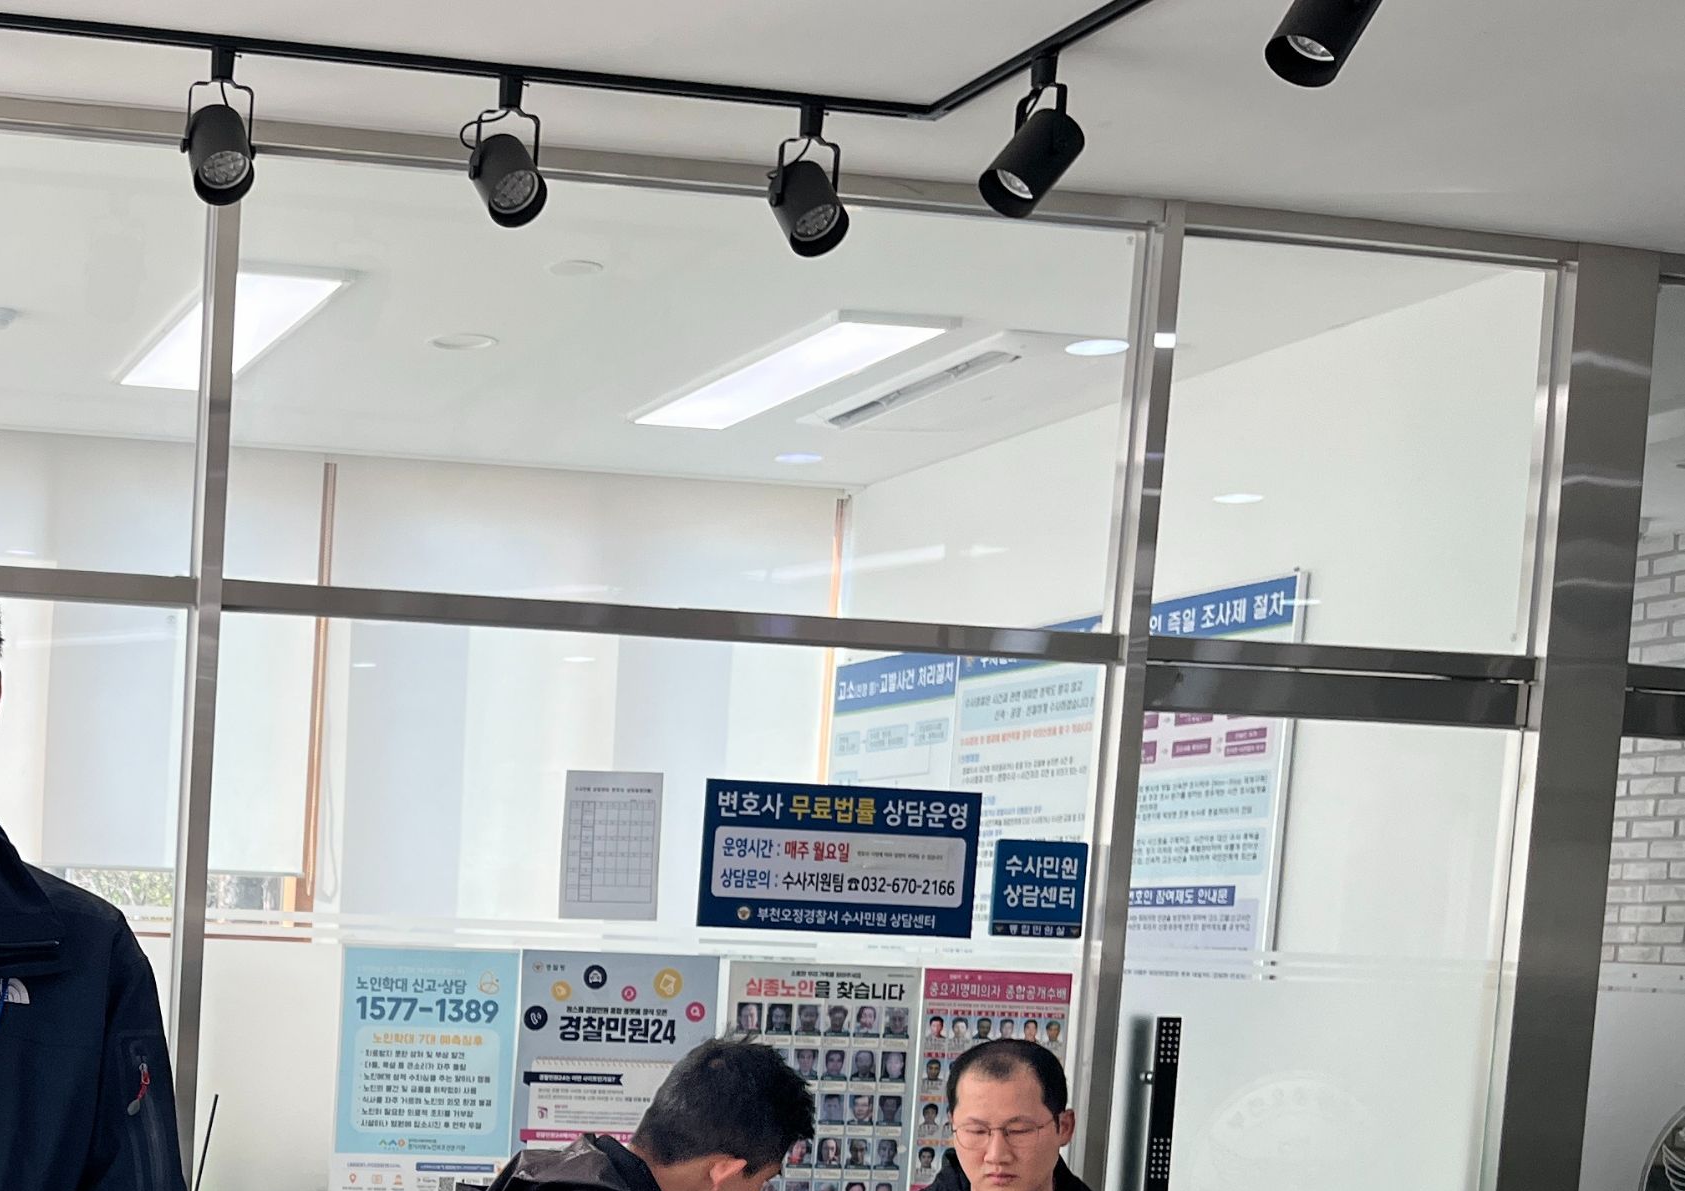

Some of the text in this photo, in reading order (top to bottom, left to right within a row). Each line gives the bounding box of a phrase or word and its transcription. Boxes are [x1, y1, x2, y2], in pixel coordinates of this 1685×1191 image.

[1200, 597, 1247, 629] 조사제
[1253, 590, 1285, 621] 절차
[717, 790, 784, 820] 변호사
[789, 795, 876, 826] 무료법률
[882, 799, 970, 830] 상담운영
[722, 837, 774, 859] 운영시간
[784, 841, 809, 861] 매주
[812, 842, 850, 863] 월요일
[1005, 854, 1078, 880] 수사민원
[720, 869, 955, 896] 상담문의 수사지원팀 032-670-2166
[1003, 884, 1076, 910] 상담센터
[1197, 887, 1229, 905] 안내문
[757, 906, 936, 930] 부천오정경찰서 수사민원 상담센터
[356, 976, 467, 995] 노인학대 신고·상담
[746, 977, 906, 1001] 실종노인을 찾습니다
[1006, 984, 1067, 1001] 종합공개수배
[356, 995, 500, 1024] 1577-1389
[372, 1032, 415, 1045] 노인학대
[559, 1015, 677, 1045] 경찰민원24
